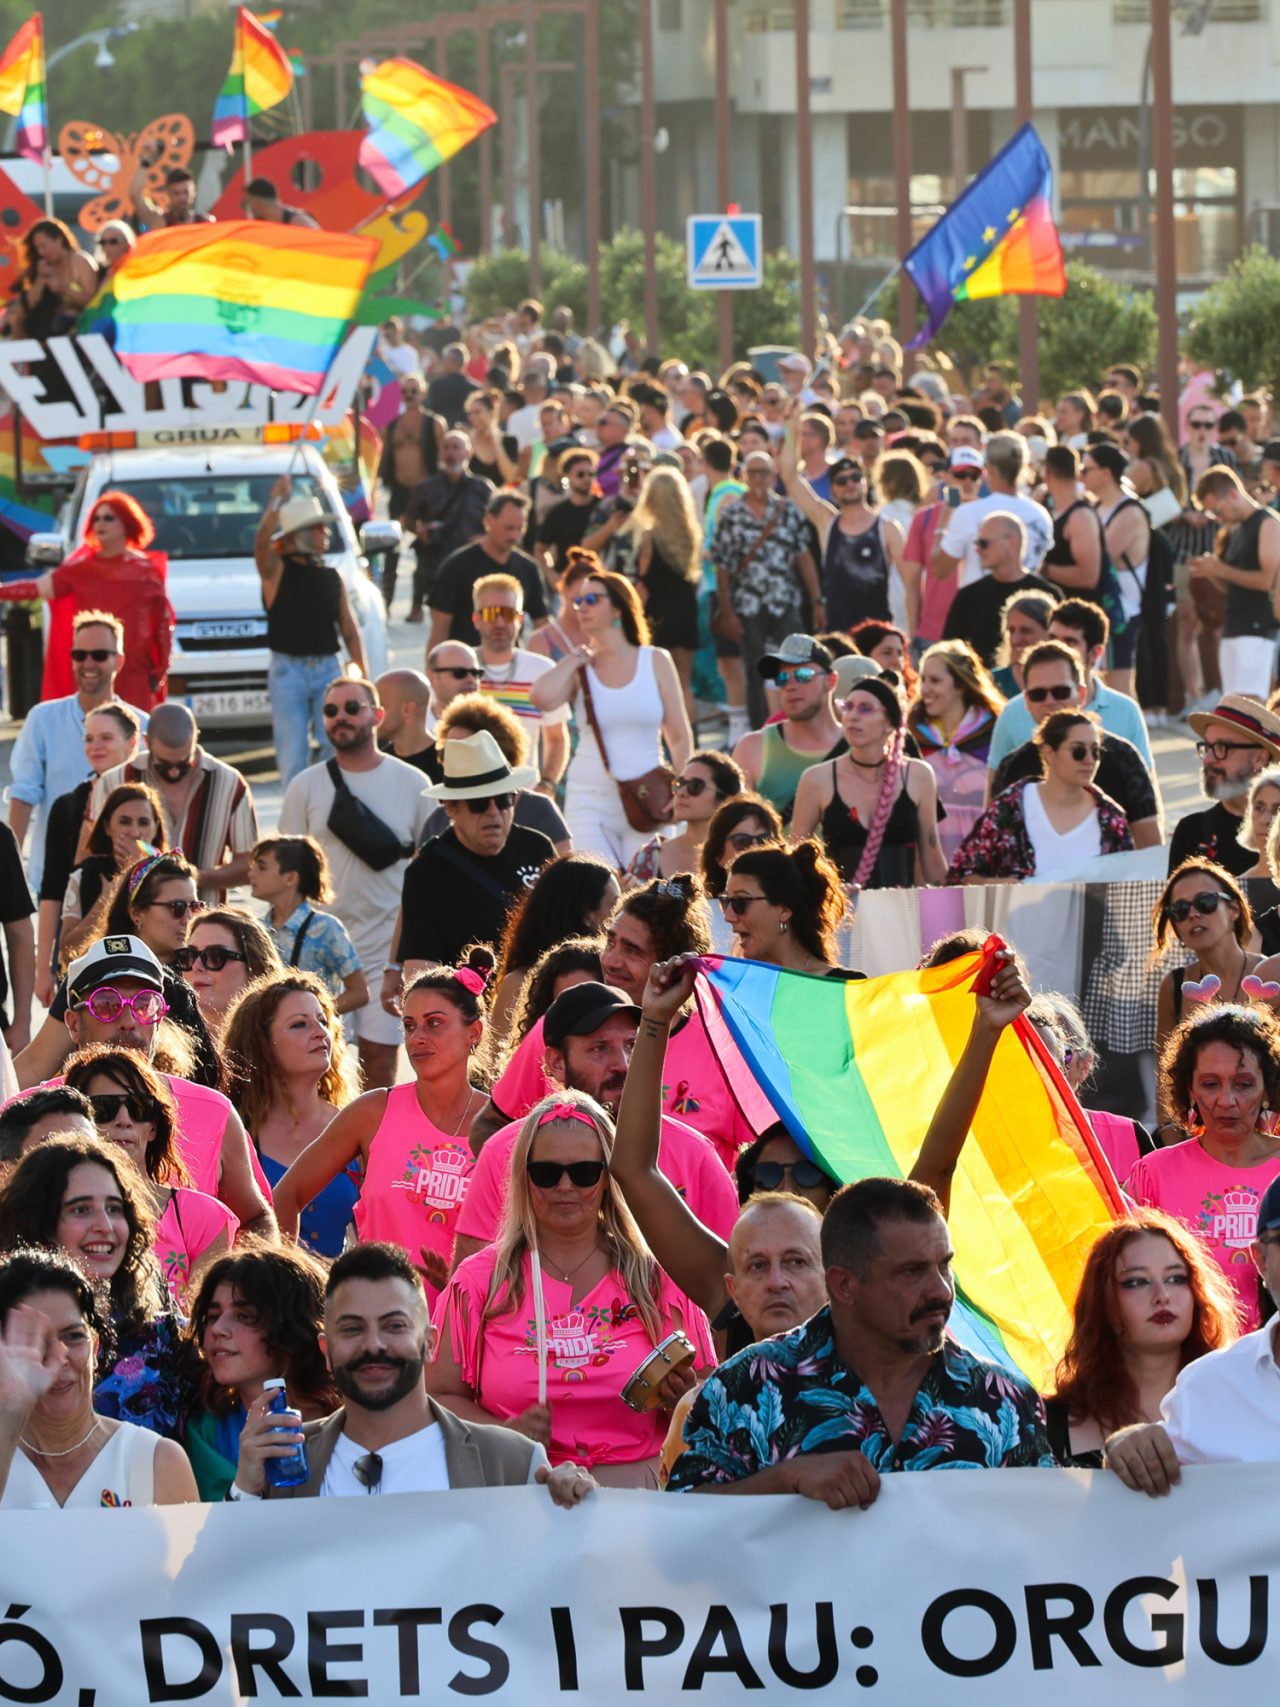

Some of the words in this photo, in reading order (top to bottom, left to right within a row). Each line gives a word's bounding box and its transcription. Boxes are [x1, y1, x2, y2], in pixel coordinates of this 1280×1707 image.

[153, 428, 242, 444] GRUA
[416, 1168, 471, 1202] PRIDE
[544, 1333, 600, 1357] PRIDE
[140, 1603, 509, 1703] DRETS
[551, 1606, 578, 1691] I
[619, 1601, 879, 1690] PAU:
[921, 1575, 1270, 1678] ORGU
